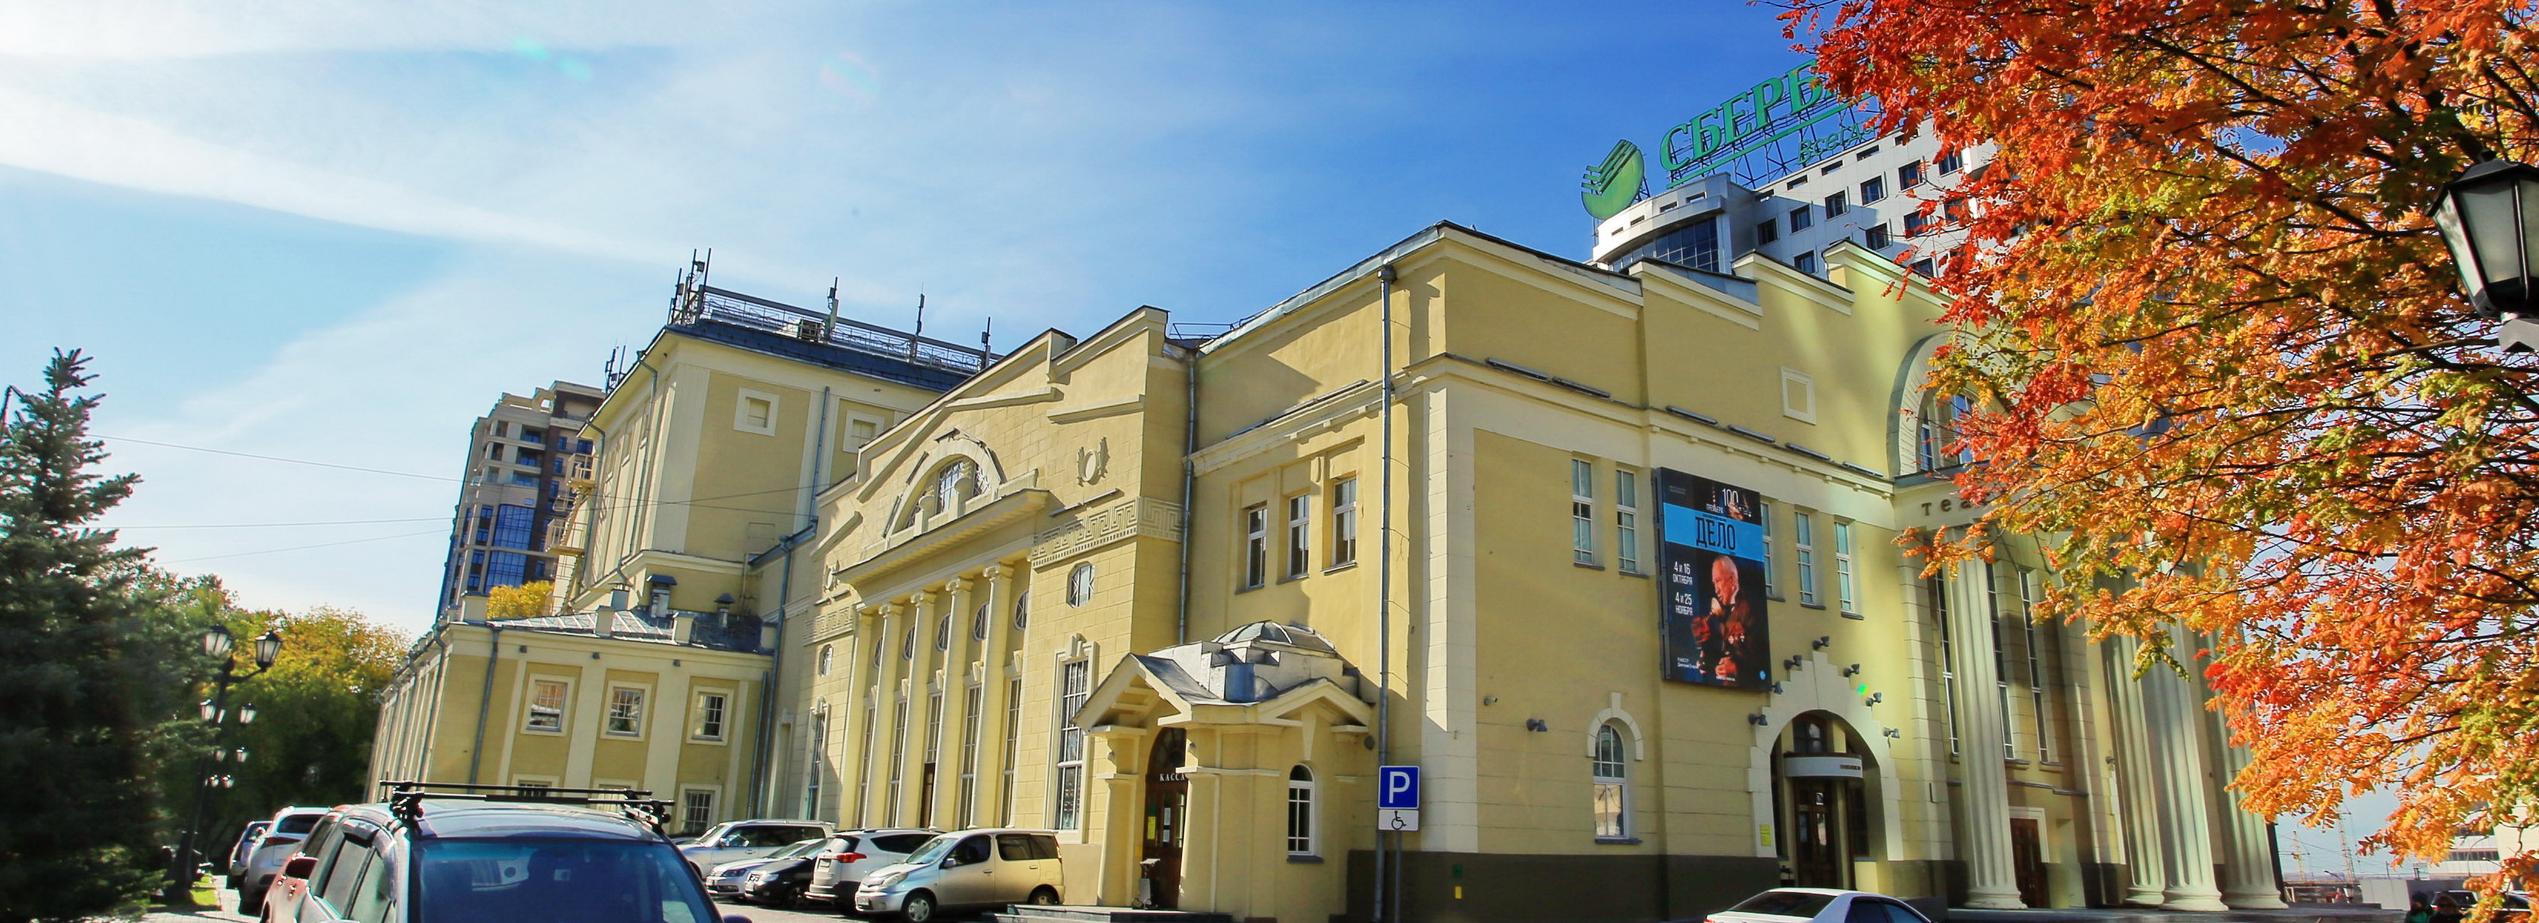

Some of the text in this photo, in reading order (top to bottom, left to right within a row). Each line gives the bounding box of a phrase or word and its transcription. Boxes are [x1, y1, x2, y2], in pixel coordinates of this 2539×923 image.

[1659, 59, 1837, 171] СБЕРБ
[1695, 516, 1736, 551] ДЕЛО
[1674, 561, 1679, 573] 4
[1675, 591, 1680, 603] 4
[1684, 593, 1692, 606] 25
[1159, 772, 1186, 783] КАССА
[1389, 771, 1411, 804] P
